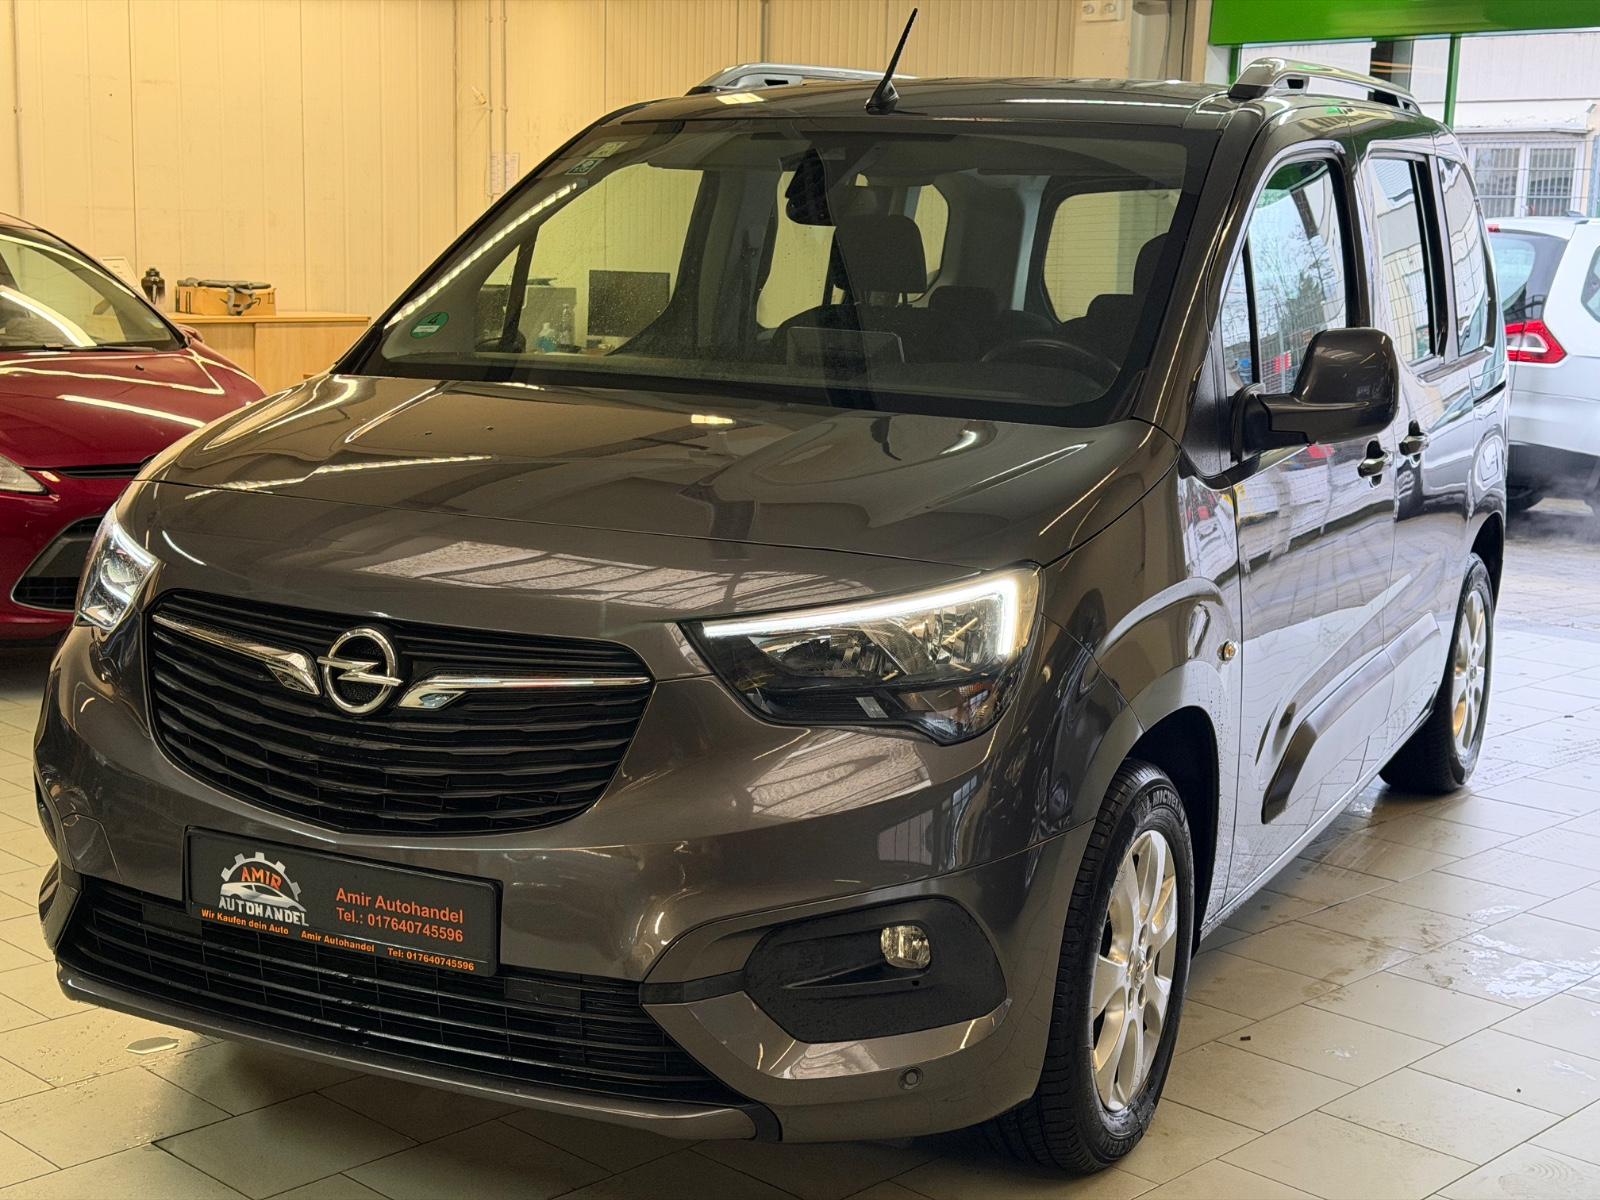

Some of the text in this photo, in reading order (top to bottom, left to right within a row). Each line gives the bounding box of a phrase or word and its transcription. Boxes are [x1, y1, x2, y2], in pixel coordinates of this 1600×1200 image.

[241, 866, 282, 890] AMIR
[219, 896, 309, 927] AUTOHANDEL
[336, 888, 464, 924] Amir Autohandel
[202, 909, 289, 935] Wir Kaufen dein Auto
[336, 907, 464, 943] Tel.: 017640745596
[301, 930, 375, 952] Amir Autohandel
[388, 947, 475, 971] Tel: 017640745596
